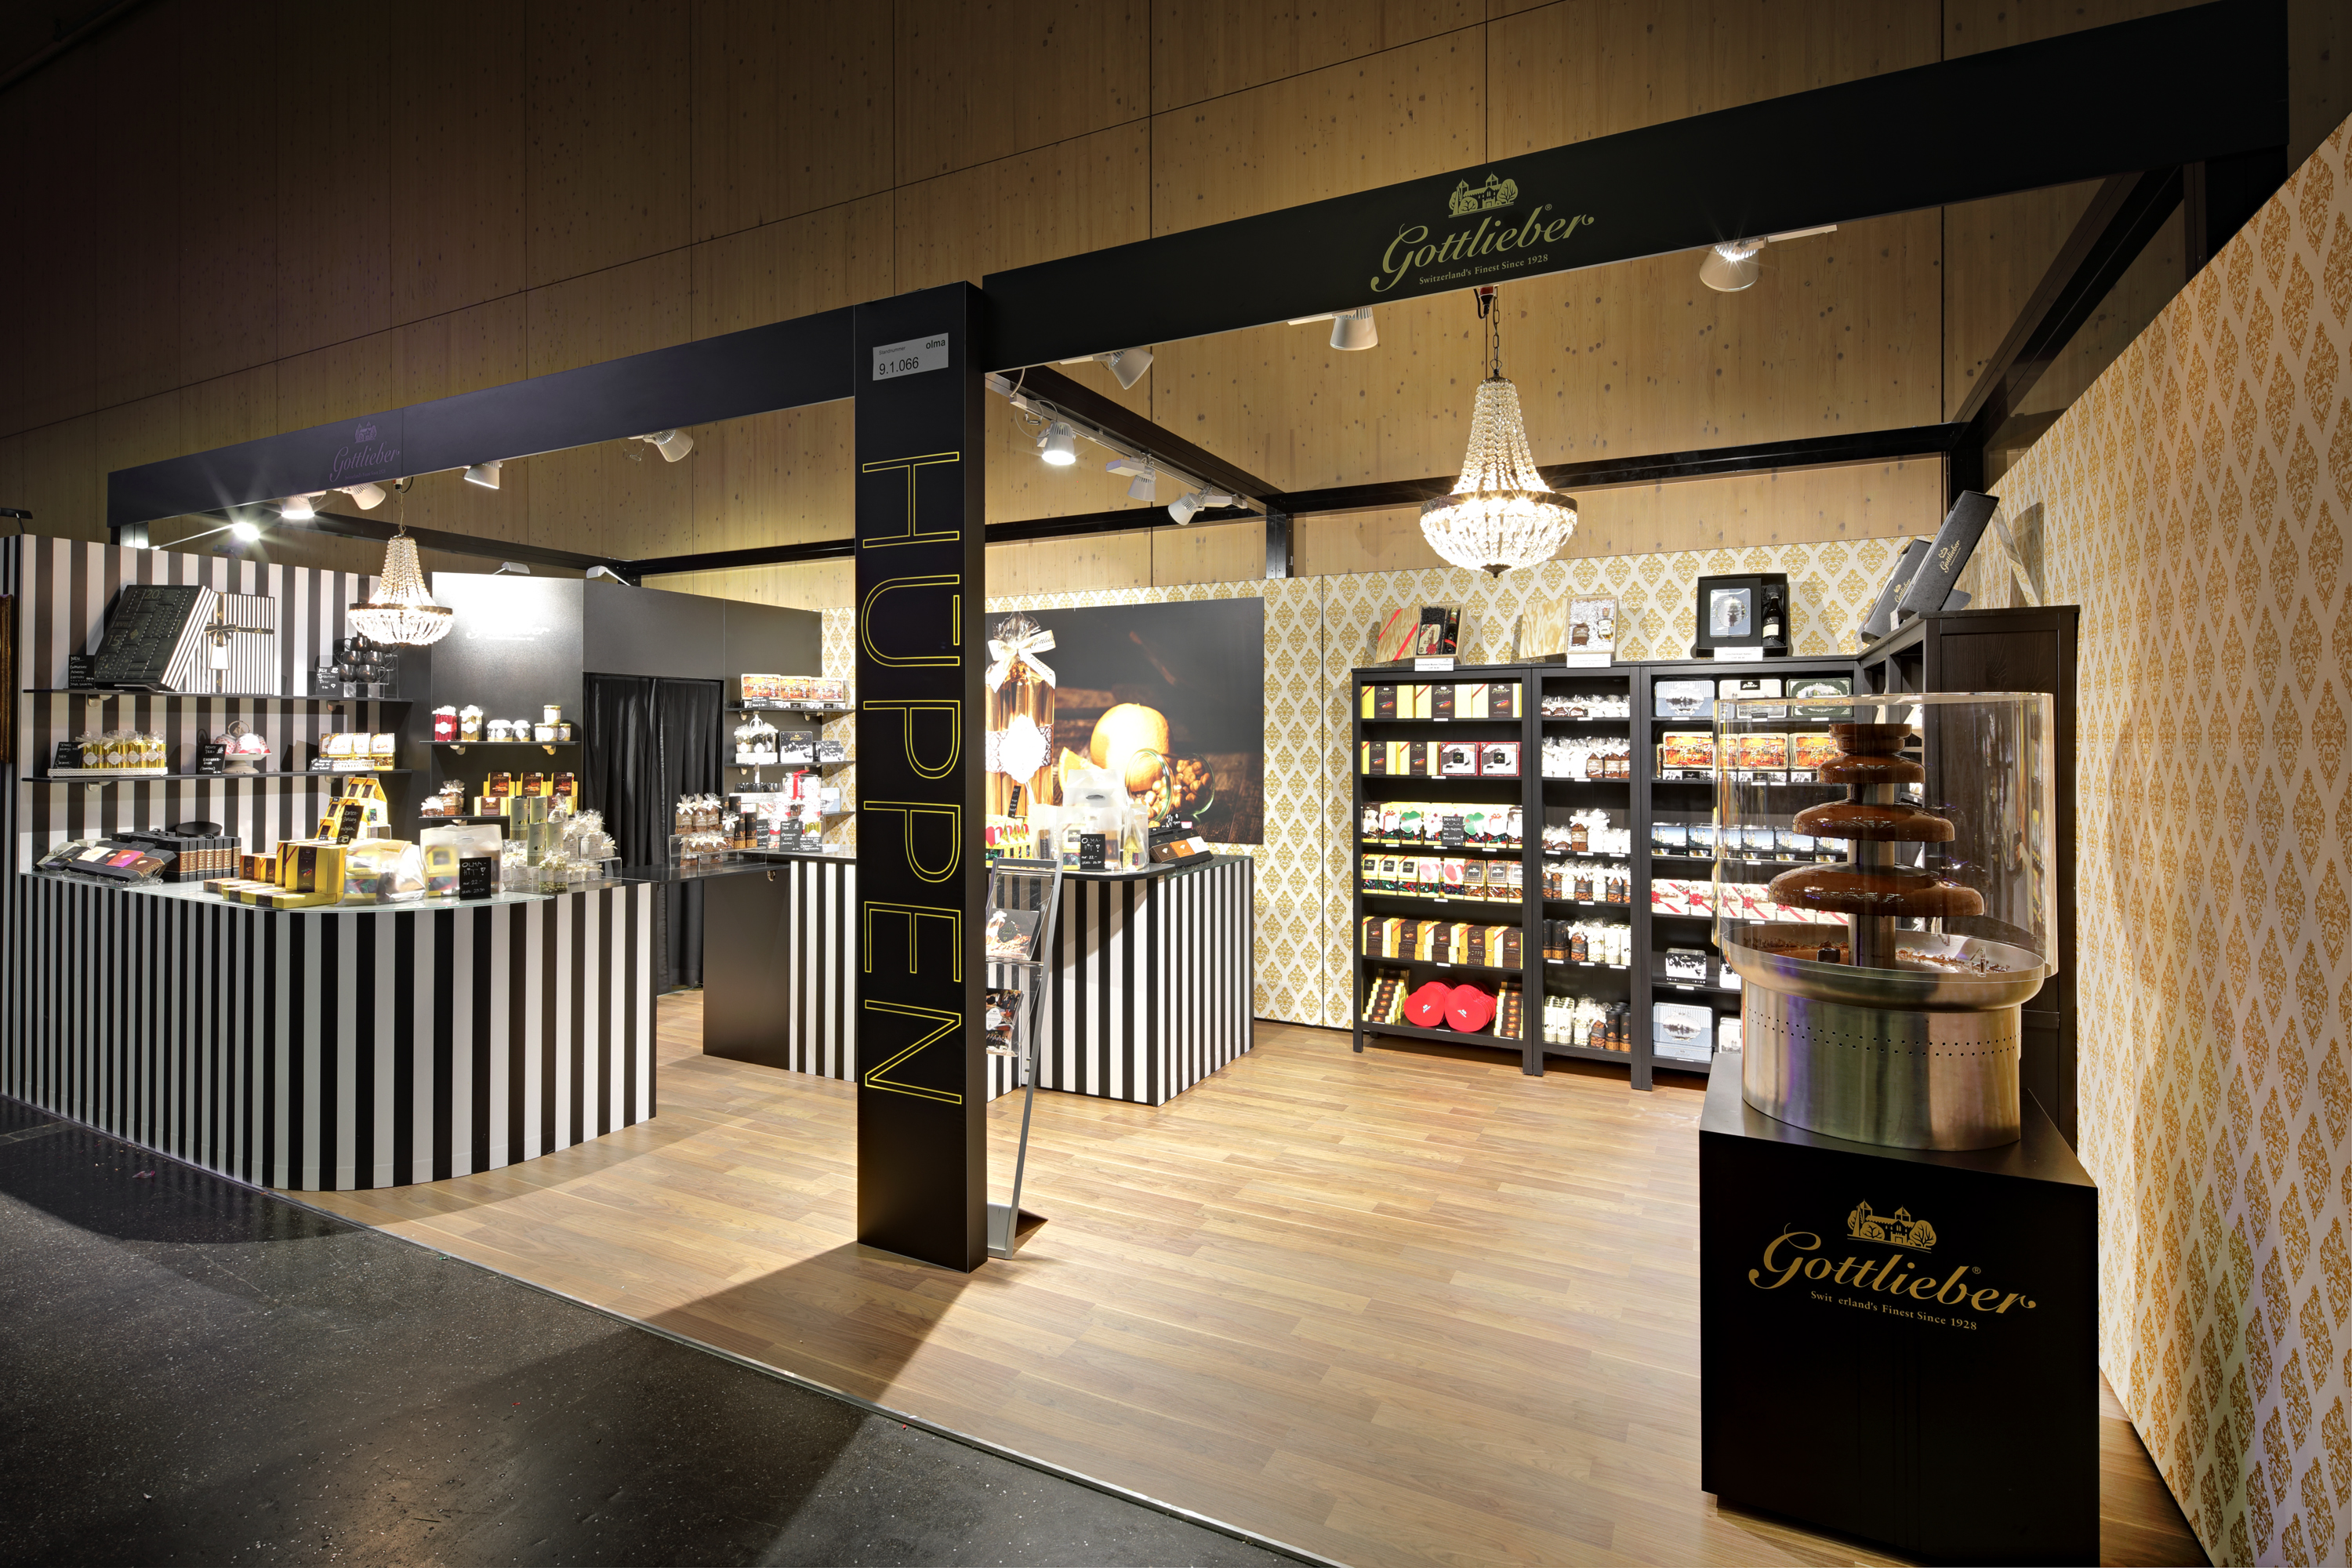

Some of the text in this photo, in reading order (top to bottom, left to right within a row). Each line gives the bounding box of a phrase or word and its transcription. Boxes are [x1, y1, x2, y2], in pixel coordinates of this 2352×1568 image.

[1370, 205, 1594, 292] Gottlieber
[1419, 254, 1548, 285] Switzerland's Finest Since 1928
[879, 339, 946, 355] Standnummer olma
[879, 357, 919, 376] 9.1.066
[330, 441, 400, 482] Gottlieber
[144, 590, 160, 599] 20
[107, 635, 122, 647] 15
[1748, 1223, 2036, 1314] Gottlieber
[1811, 1290, 1976, 1331] Switerland's Finest Since 1928
